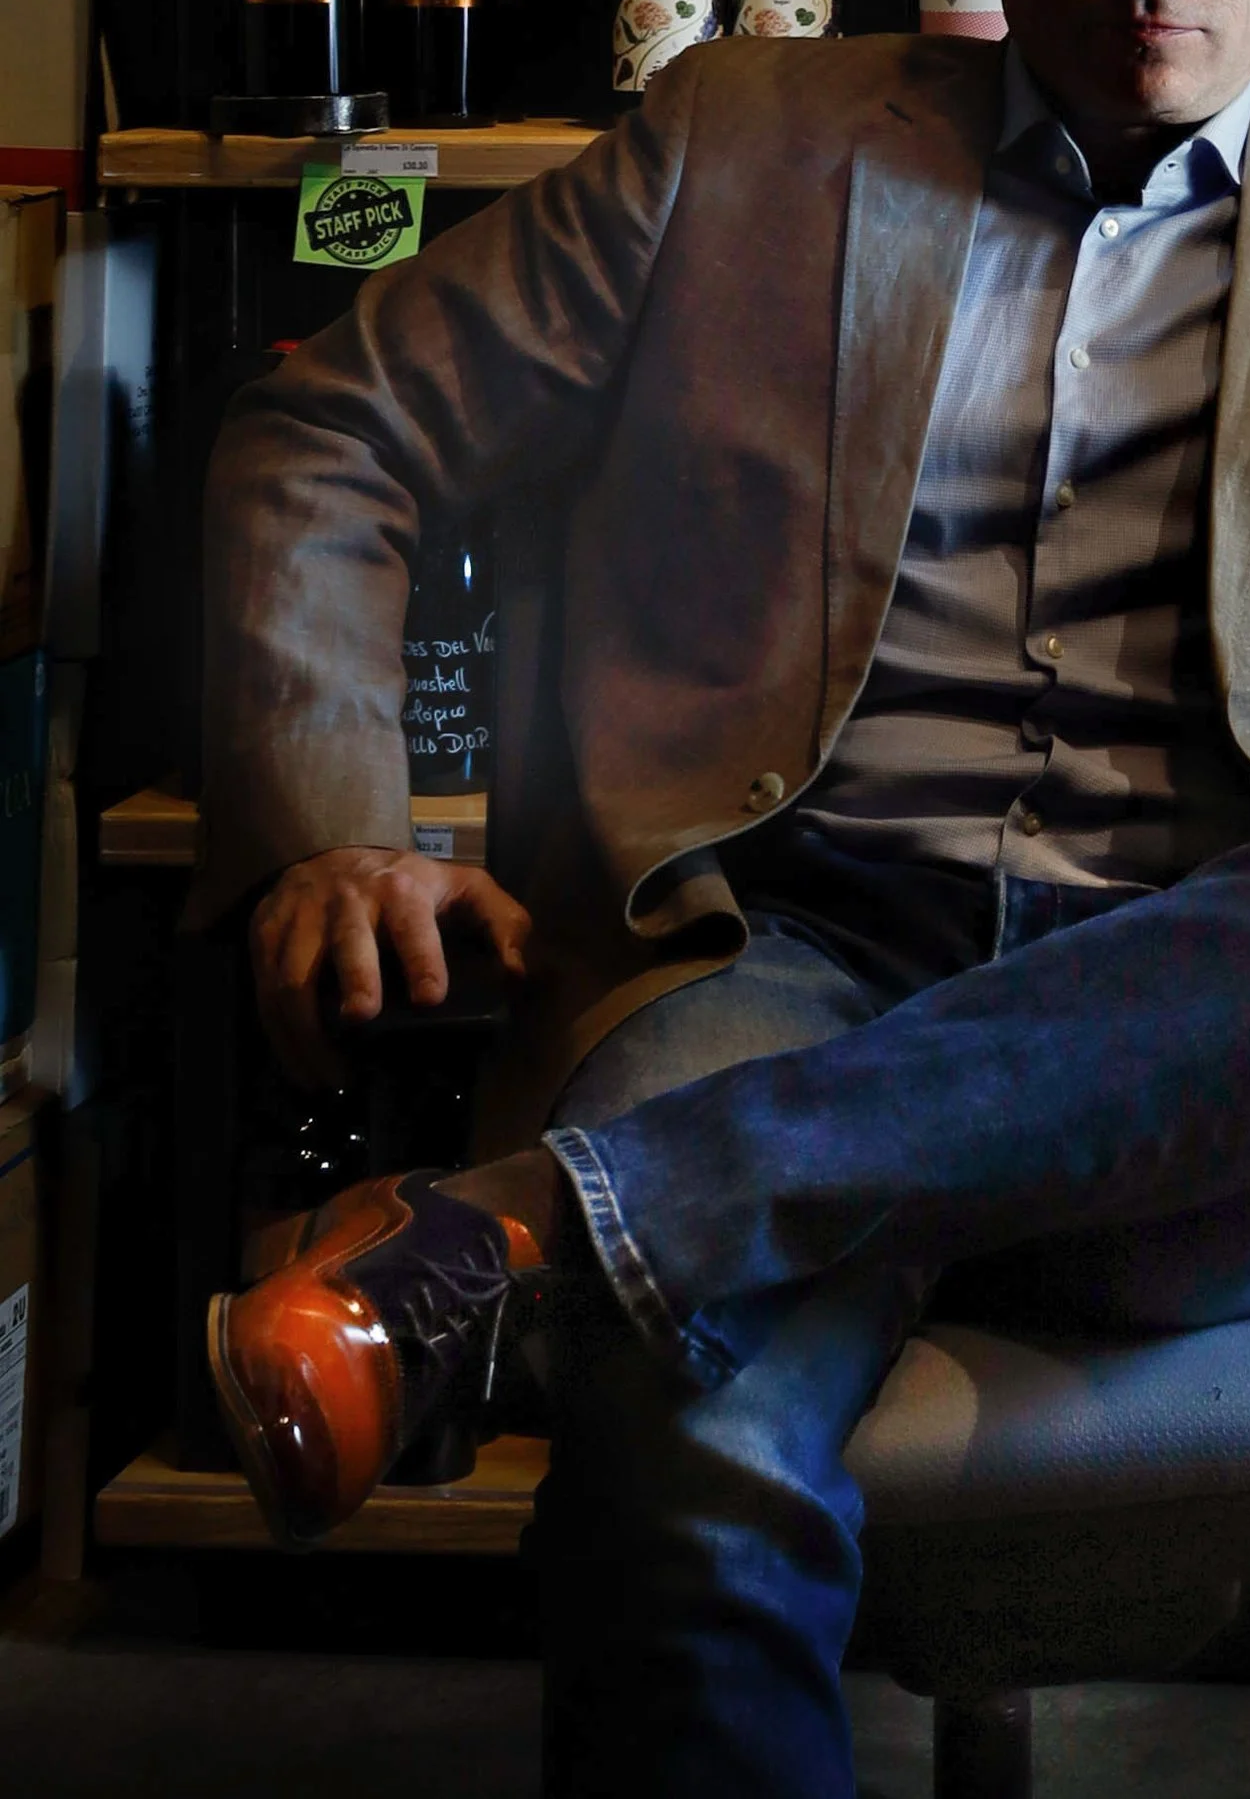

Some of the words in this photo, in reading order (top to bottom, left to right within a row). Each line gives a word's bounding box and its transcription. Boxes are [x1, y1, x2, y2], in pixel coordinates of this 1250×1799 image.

[323, 182, 354, 209] STAFF
[357, 181, 387, 198] PICK
[314, 210, 362, 240] STAFF
[365, 201, 404, 227] PICK
[333, 242, 367, 257] STAFF
[372, 229, 397, 254] PICK
[432, 640, 470, 657] DEL
